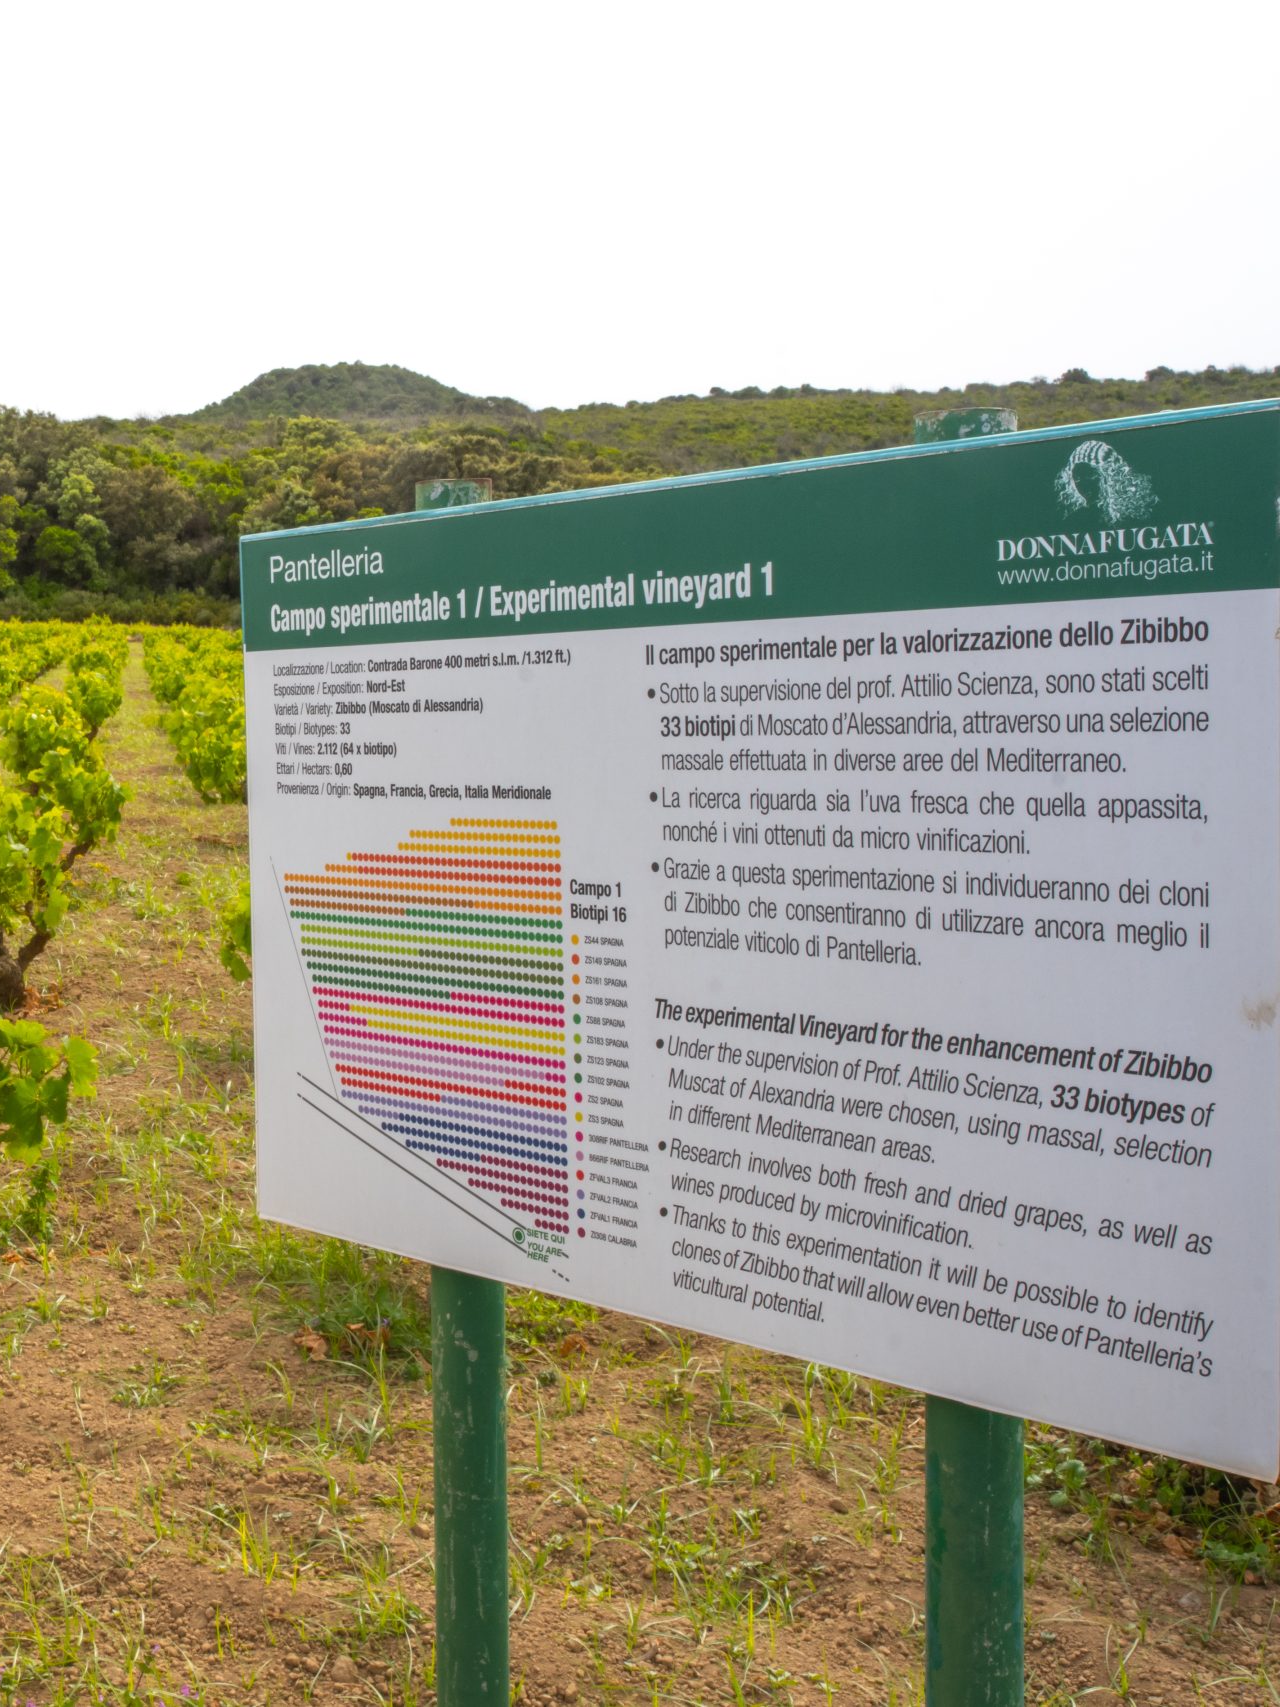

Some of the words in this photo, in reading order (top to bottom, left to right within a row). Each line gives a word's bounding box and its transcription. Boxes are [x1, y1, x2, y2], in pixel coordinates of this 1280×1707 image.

[996, 522, 1215, 562] DONNAFUGATA
[270, 546, 383, 583] Pantelleria
[997, 550, 1214, 585] www.donnafugata.it
[270, 604, 325, 636] Campo
[330, 590, 450, 634] sperimentale
[456, 588, 465, 618] 1
[490, 573, 634, 621] Experimental
[642, 563, 750, 608] vineyard
[761, 561, 772, 595] 1
[646, 644, 654, 665] Il
[659, 646, 714, 668] campo
[720, 635, 836, 666] sperimentale
[843, 637, 874, 661] per
[880, 632, 897, 654] la
[903, 625, 1052, 654] valorizzazione
[1059, 621, 1113, 647] dello
[1120, 616, 1209, 644] Zibibbo
[273, 664, 324, 676] Localizzazione
[330, 660, 365, 674] Location:
[367, 657, 407, 672] Contrada
[409, 657, 442, 670] Barone
[444, 654, 462, 668] 400
[464, 652, 490, 667] metri
[273, 682, 315, 698] Esposizione
[322, 681, 363, 696] Exposition:
[366, 678, 405, 693] Nord-Est
[273, 702, 298, 715] Varietà
[305, 702, 333, 717] Variety:
[335, 701, 366, 714] Zibibbo
[368, 700, 410, 716] (Moscato
[412, 699, 421, 712] di
[423, 697, 483, 714] Alessandria)
[660, 715, 681, 737] 33
[685, 714, 735, 741] biotipi
[739, 714, 753, 736] di
[758, 714, 828, 736] Moscato
[963, 711, 1060, 734] attraverso
[1066, 713, 1104, 733] una
[1109, 706, 1209, 732] selezione
[274, 722, 296, 737] Biotipi
[303, 722, 337, 737] Biotypes:
[339, 721, 350, 735] 33
[275, 742, 286, 754] Viti
[292, 742, 315, 755] Vines:
[339, 742, 354, 758] (64
[356, 745, 361, 755] x
[363, 741, 397, 758] biotipo)
[661, 749, 723, 770] massale
[729, 748, 806, 770] effettuata
[813, 748, 827, 771] in
[834, 748, 895, 771] diverse
[902, 753, 943, 771] aree
[951, 747, 978, 772] del
[987, 747, 1126, 772] Mediterraneo.
[276, 761, 294, 774] Ettari
[301, 762, 332, 775] Hectars:
[276, 781, 319, 795] Provenienza
[326, 782, 350, 798] Origin:
[353, 783, 387, 799] Spagna,
[390, 783, 426, 800] Francia,
[428, 784, 461, 800] Grecia,
[464, 784, 489, 798] Italia
[491, 784, 551, 800] Meridionale
[662, 786, 680, 808] La
[689, 787, 741, 809] ricerca
[750, 788, 816, 815] riguarda
[826, 789, 850, 812] sia
[910, 789, 968, 814] fresca
[979, 791, 1014, 815] che
[1026, 792, 1086, 821] quella
[1098, 793, 1207, 824] appassita,
[569, 878, 611, 899] Campo
[615, 882, 620, 897] 1
[664, 857, 709, 880] Grazie
[716, 864, 725, 881] a
[732, 863, 785, 887] questa
[792, 865, 934, 893] sperimentazione
[942, 870, 956, 894] si
[966, 871, 1110, 902] individueranno
[1119, 878, 1149, 904] dei
[1159, 880, 1209, 907] cloni
[570, 903, 608, 924] Biotipi
[612, 906, 626, 922] 16
[665, 926, 739, 950] potenziale
[744, 930, 799, 955] viticolo
[805, 935, 819, 957] di
[827, 935, 921, 966] Pantelleria.
[655, 998, 682, 1021] The
[685, 1006, 796, 1034] experimental
[799, 1014, 878, 1045] Vineyard
[881, 1023, 909, 1047] for
[911, 1027, 943, 1052] the
[946, 1033, 1096, 1070] enhancement
[1098, 1048, 1124, 1072] of
[1123, 1050, 1212, 1083] Zibibbo
[668, 1067, 726, 1095] Muscat
[729, 1077, 747, 1098] of
[748, 1080, 834, 1112] Alexandria
[841, 1097, 882, 1119] were
[888, 1100, 958, 1134] chosen,
[967, 1113, 1021, 1145] using
[1026, 1124, 1104, 1156] massal,
[1113, 1134, 1212, 1168] selection
[669, 1100, 682, 1121] in
[688, 1104, 751, 1133] different
[755, 1113, 875, 1153] Mediterranean
[881, 1139, 934, 1163] areas.
[671, 1172, 714, 1197] wines
[718, 1184, 795, 1213] produced
[800, 1194, 820, 1221] by
[825, 1202, 971, 1248] microvinification.
[526, 1228, 549, 1241] SIETE
[550, 1233, 565, 1245] QUI
[527, 1241, 544, 1252] YOU
[546, 1246, 562, 1257] ARE
[527, 1250, 549, 1263] HERE
[673, 1204, 726, 1234] Thanks
[732, 1218, 746, 1238] to
[752, 1222, 780, 1245] this
[786, 1233, 922, 1276] experimentation
[928, 1257, 941, 1281] it
[947, 1264, 977, 1288] will
[983, 1268, 1008, 1294] be
[1013, 1280, 1098, 1314] possible
[1107, 1295, 1126, 1319] to
[1133, 1299, 1214, 1342] identify
[673, 1269, 748, 1303] viticultural
[751, 1290, 824, 1322] potential.
